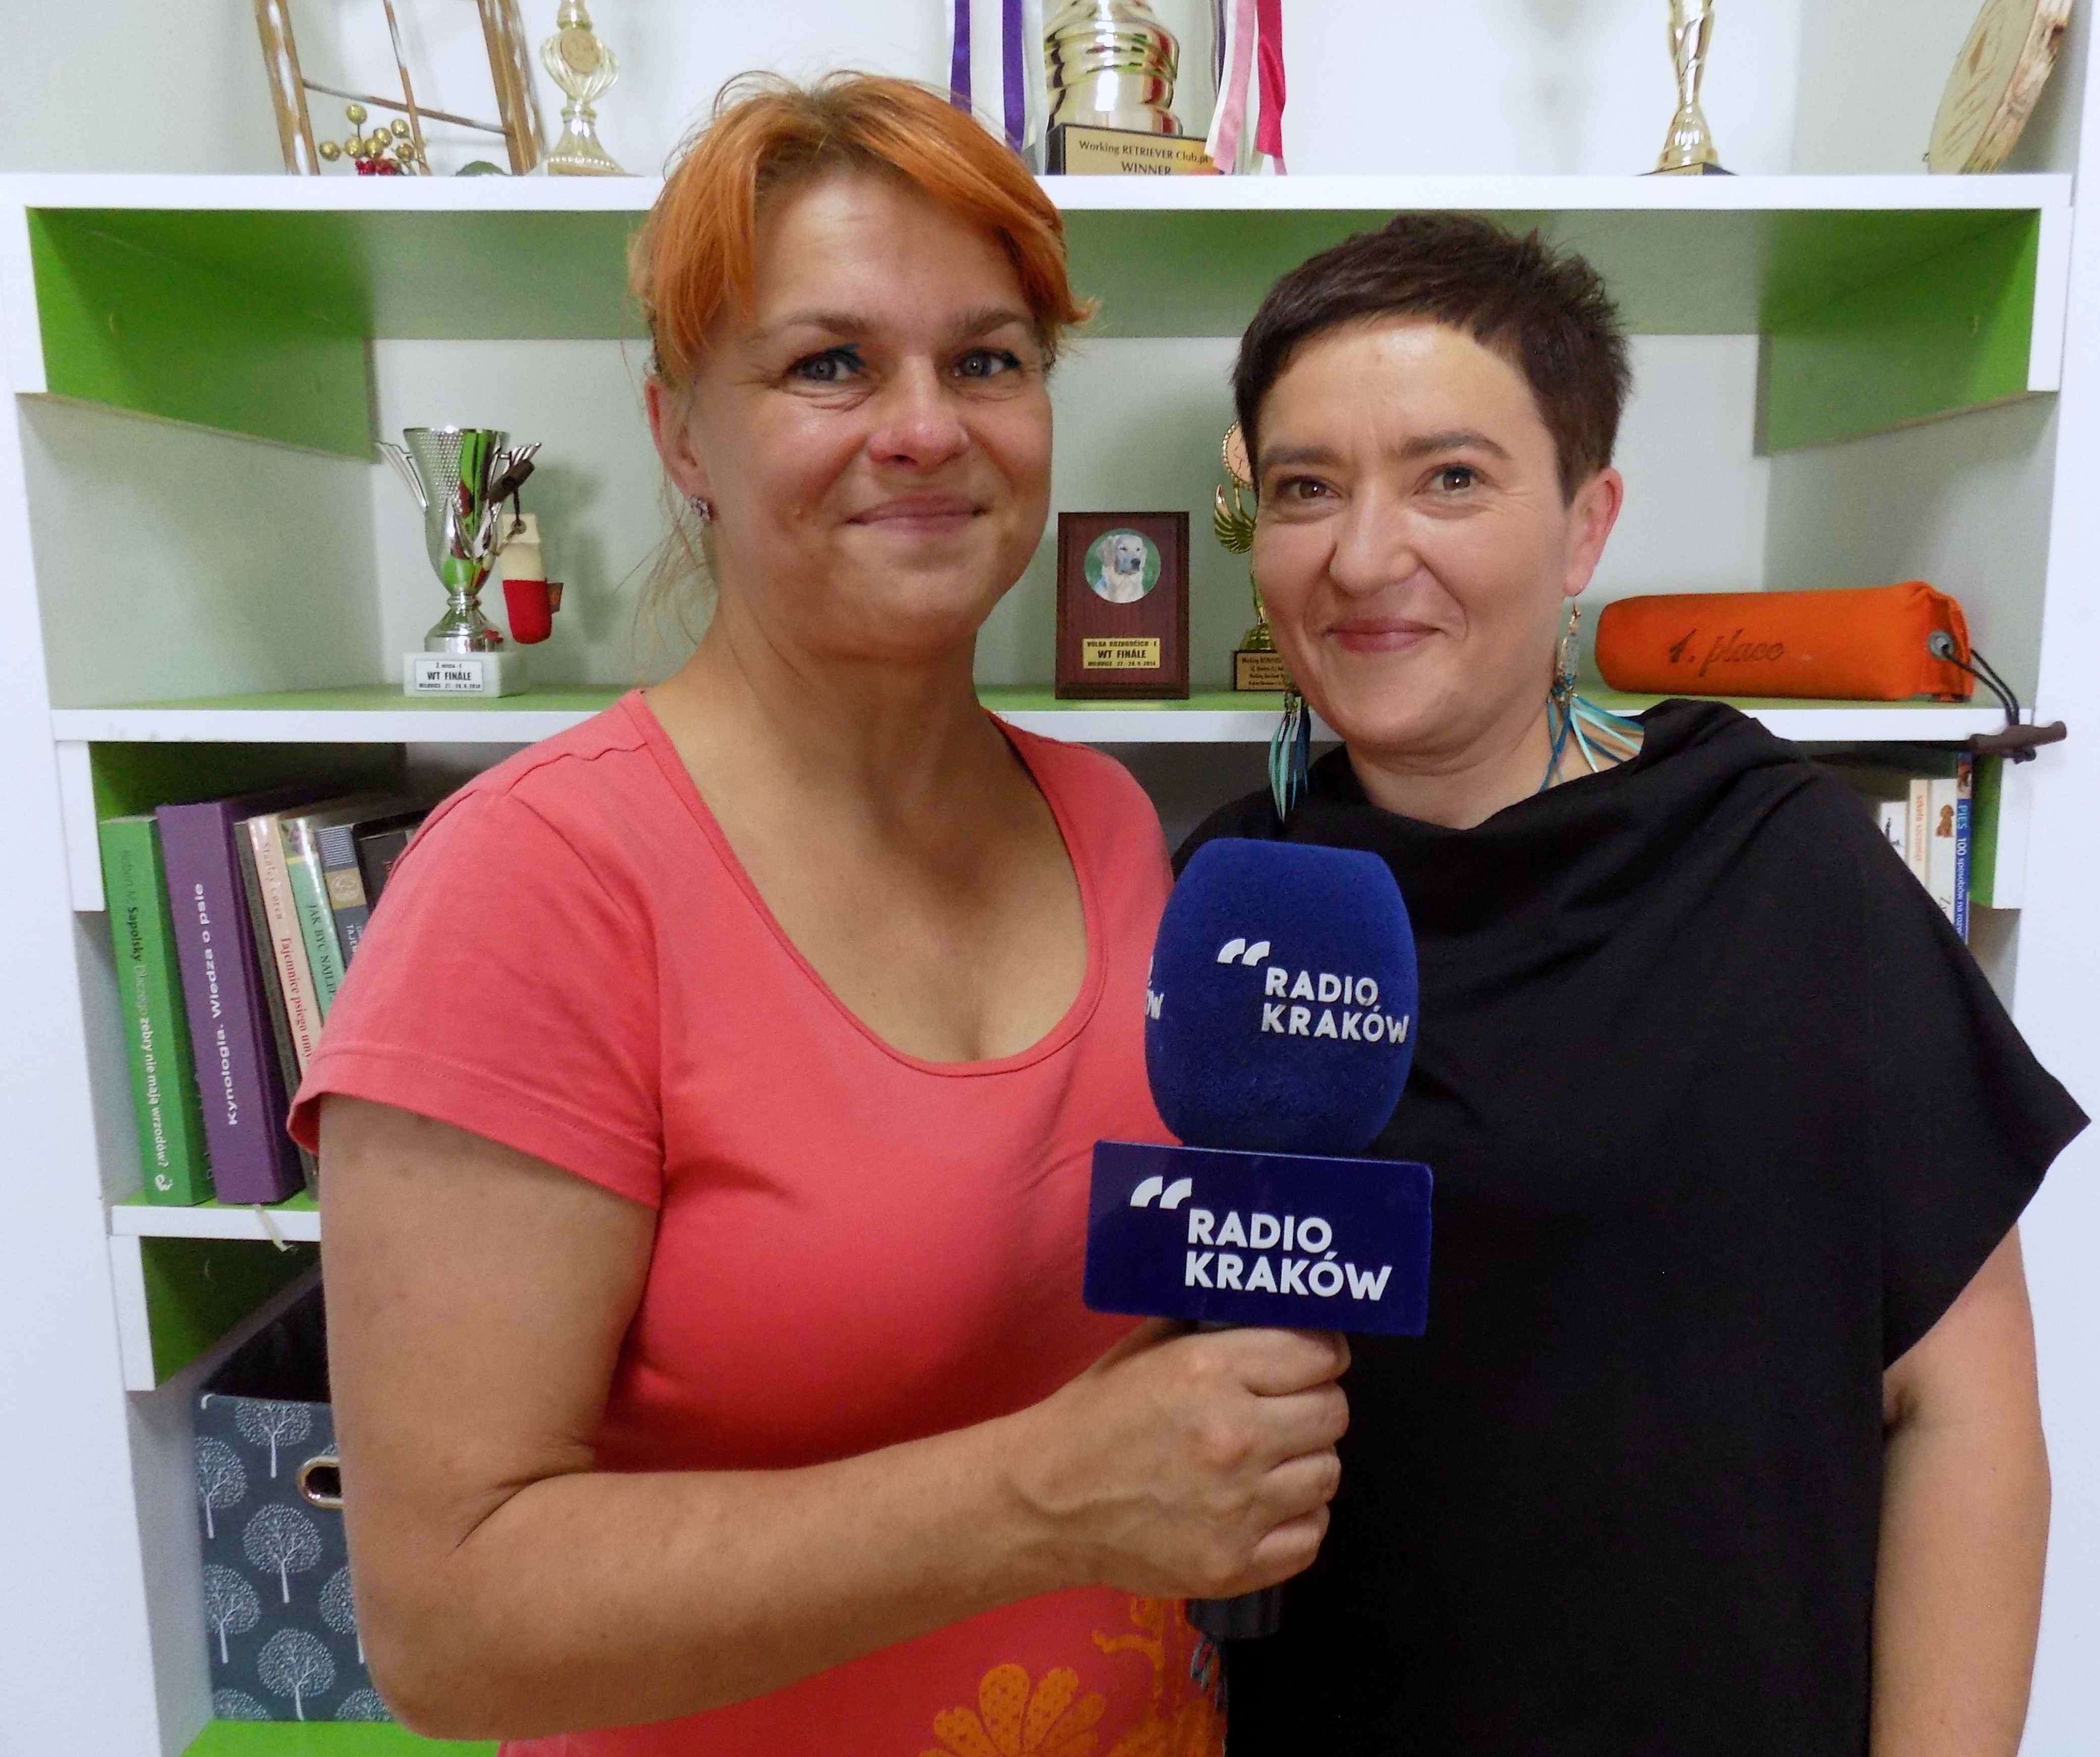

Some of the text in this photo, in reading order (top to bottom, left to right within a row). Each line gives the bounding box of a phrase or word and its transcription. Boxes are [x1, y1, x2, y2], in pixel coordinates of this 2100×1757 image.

[1079, 140, 1119, 155] Working
[1123, 145, 1173, 159] RETRIEVER
[1121, 161, 1171, 175] WINNER
[1098, 648, 1146, 659] WT FINÁLE
[1699, 629, 1784, 677] place
[427, 671, 440, 680] WT
[1957, 837, 1968, 856] 100
[1956, 858, 1966, 900] sposobów
[307, 904, 320, 925] JAK
[1956, 901, 1964, 913] na
[127, 906, 143, 962] Sapolsky
[271, 887, 283, 920] Coren
[280, 937, 300, 994] Tajemnice
[290, 996, 308, 1032] psiego
[194, 883, 239, 1127] Kynologia. Wiedza o psie
[1264, 967, 1378, 1007] RADIO
[139, 1017, 154, 1051] zebry
[1261, 1003, 1410, 1044] KRAKÓW
[144, 1054, 158, 1074] nie
[146, 1075, 162, 1105] mają
[151, 1107, 169, 1168] wrzodów?
[1187, 1209, 1333, 1254] RADIO
[1185, 1250, 1392, 1301] KRAKÓW
